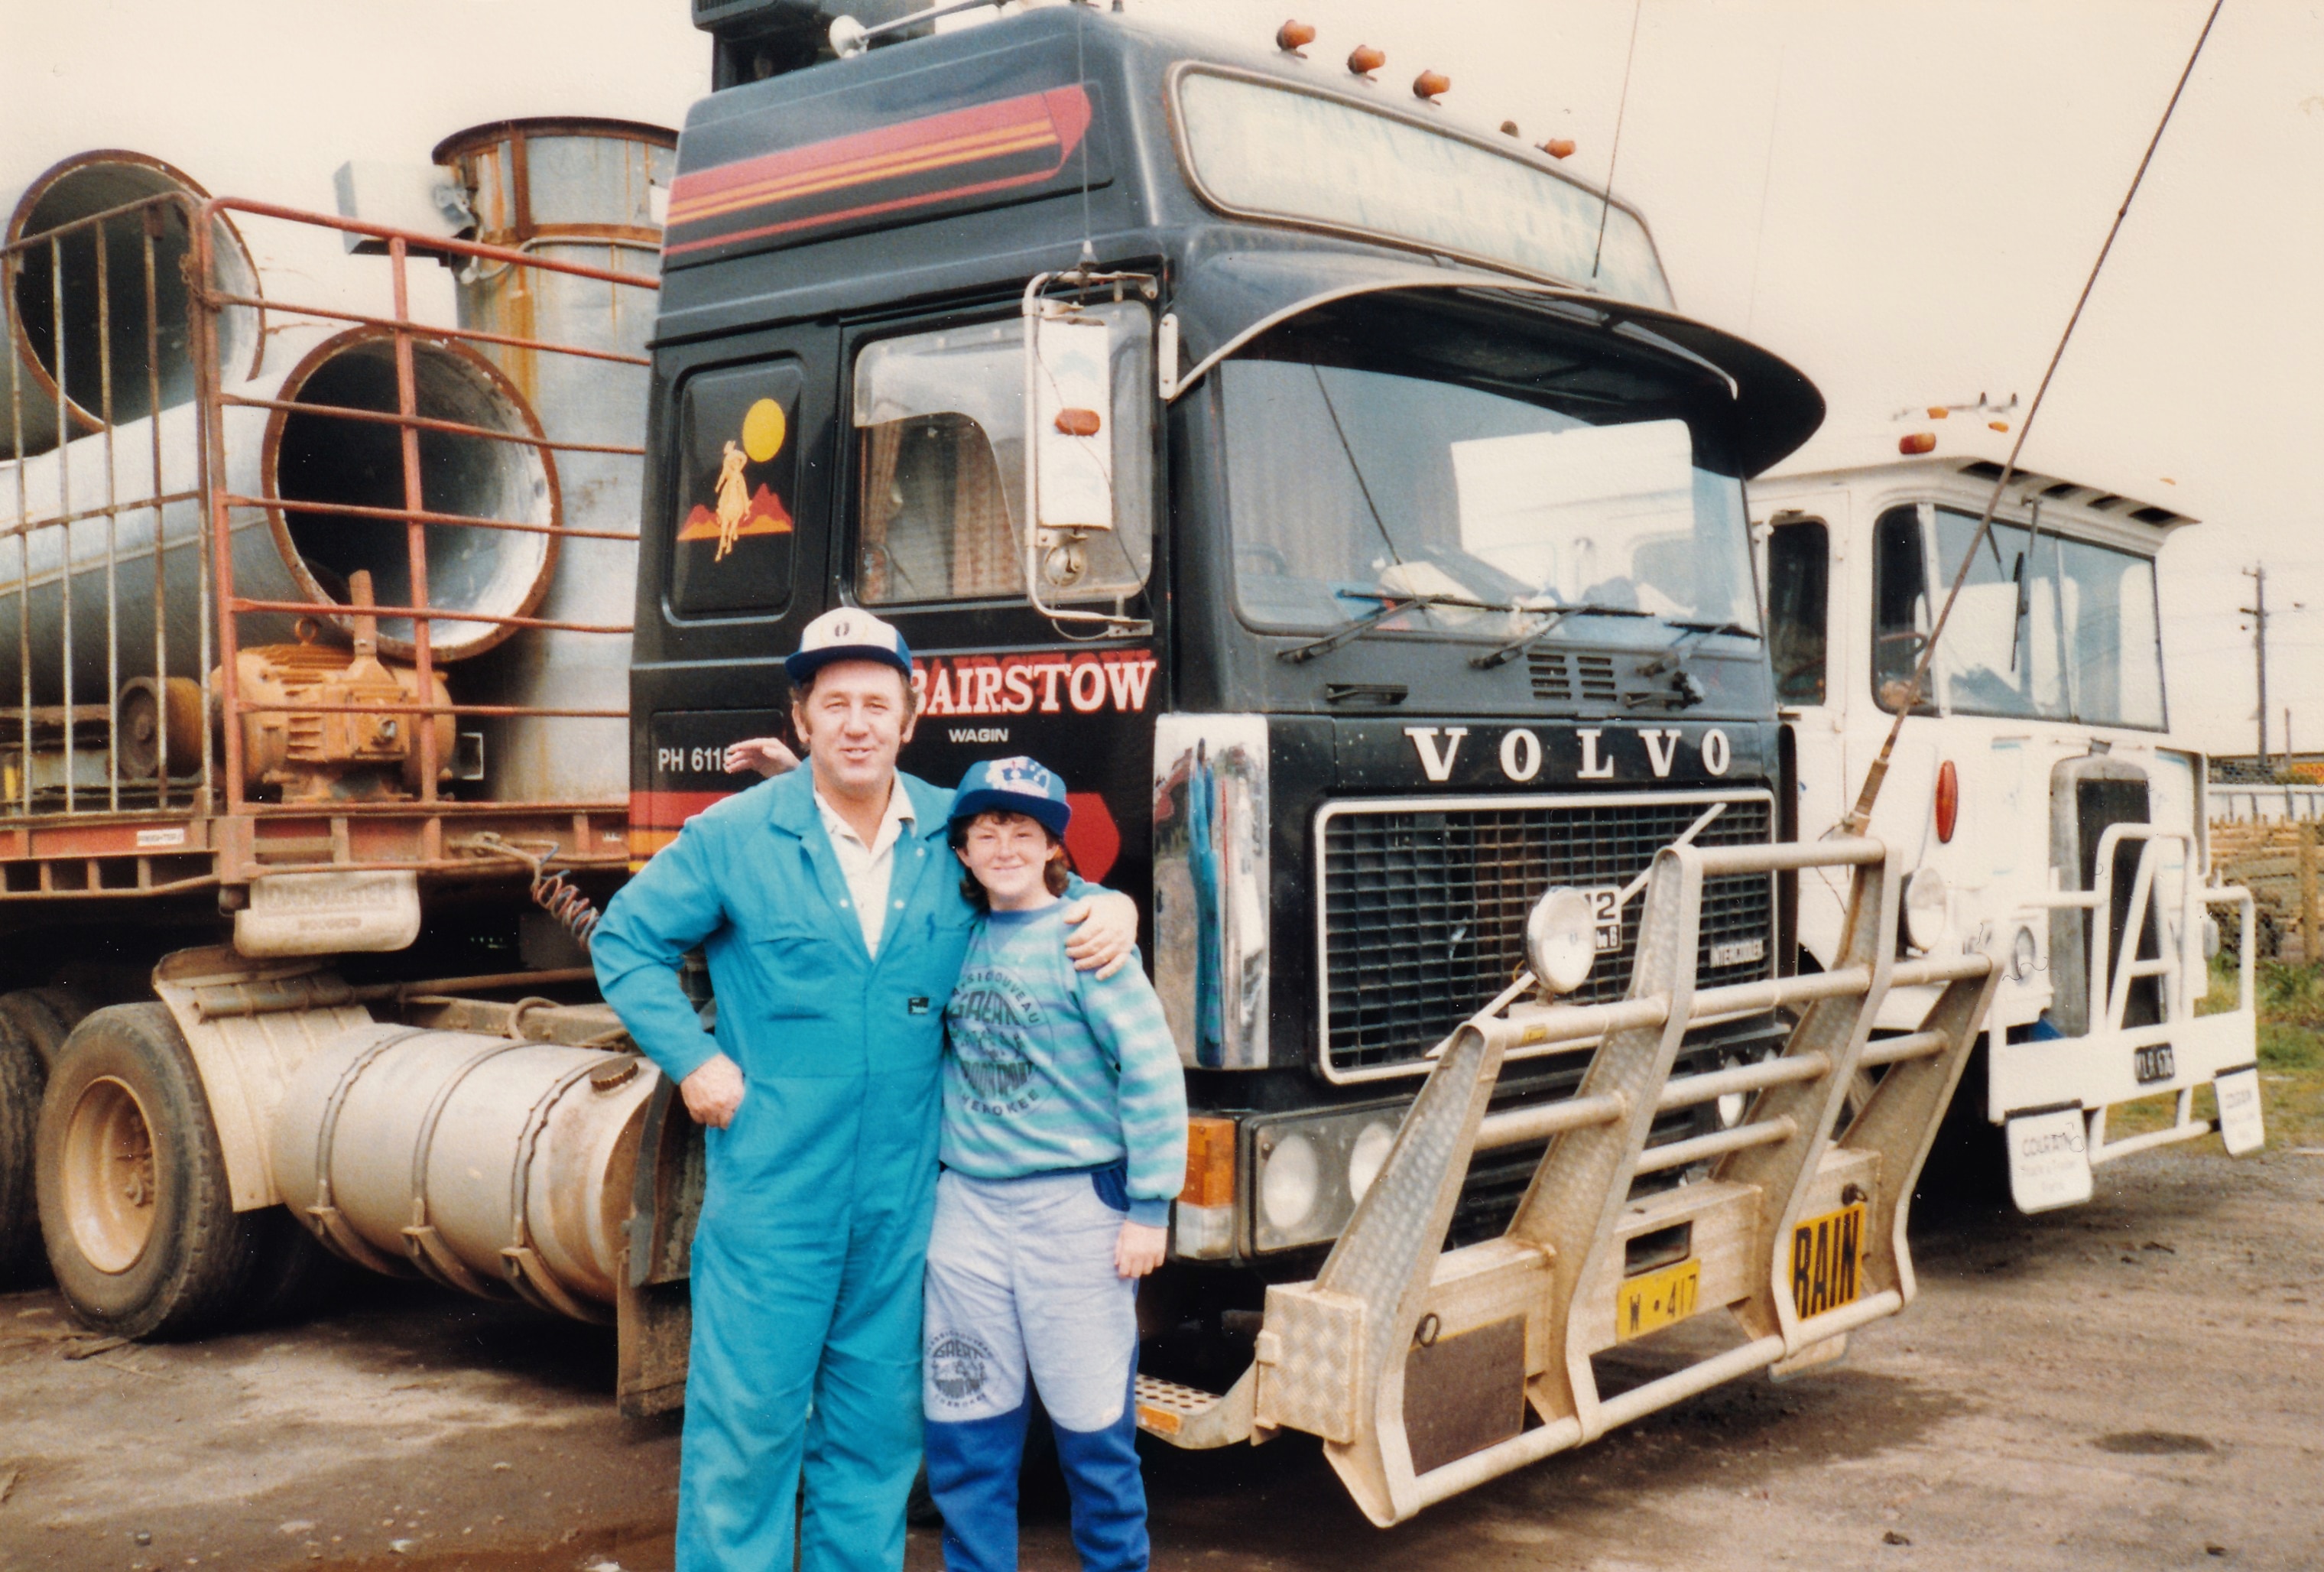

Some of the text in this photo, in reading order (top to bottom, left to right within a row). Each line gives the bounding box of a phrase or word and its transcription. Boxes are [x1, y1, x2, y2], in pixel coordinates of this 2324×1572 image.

[910, 659, 1157, 716] BAIRSTOW
[948, 728, 1010, 744] WAGIN
[1404, 726, 1731, 782] VOLVO
[658, 748, 684, 772] PH
[960, 1088, 1040, 1116] HEROKEE
[1793, 1210, 1860, 1320] RAIN
